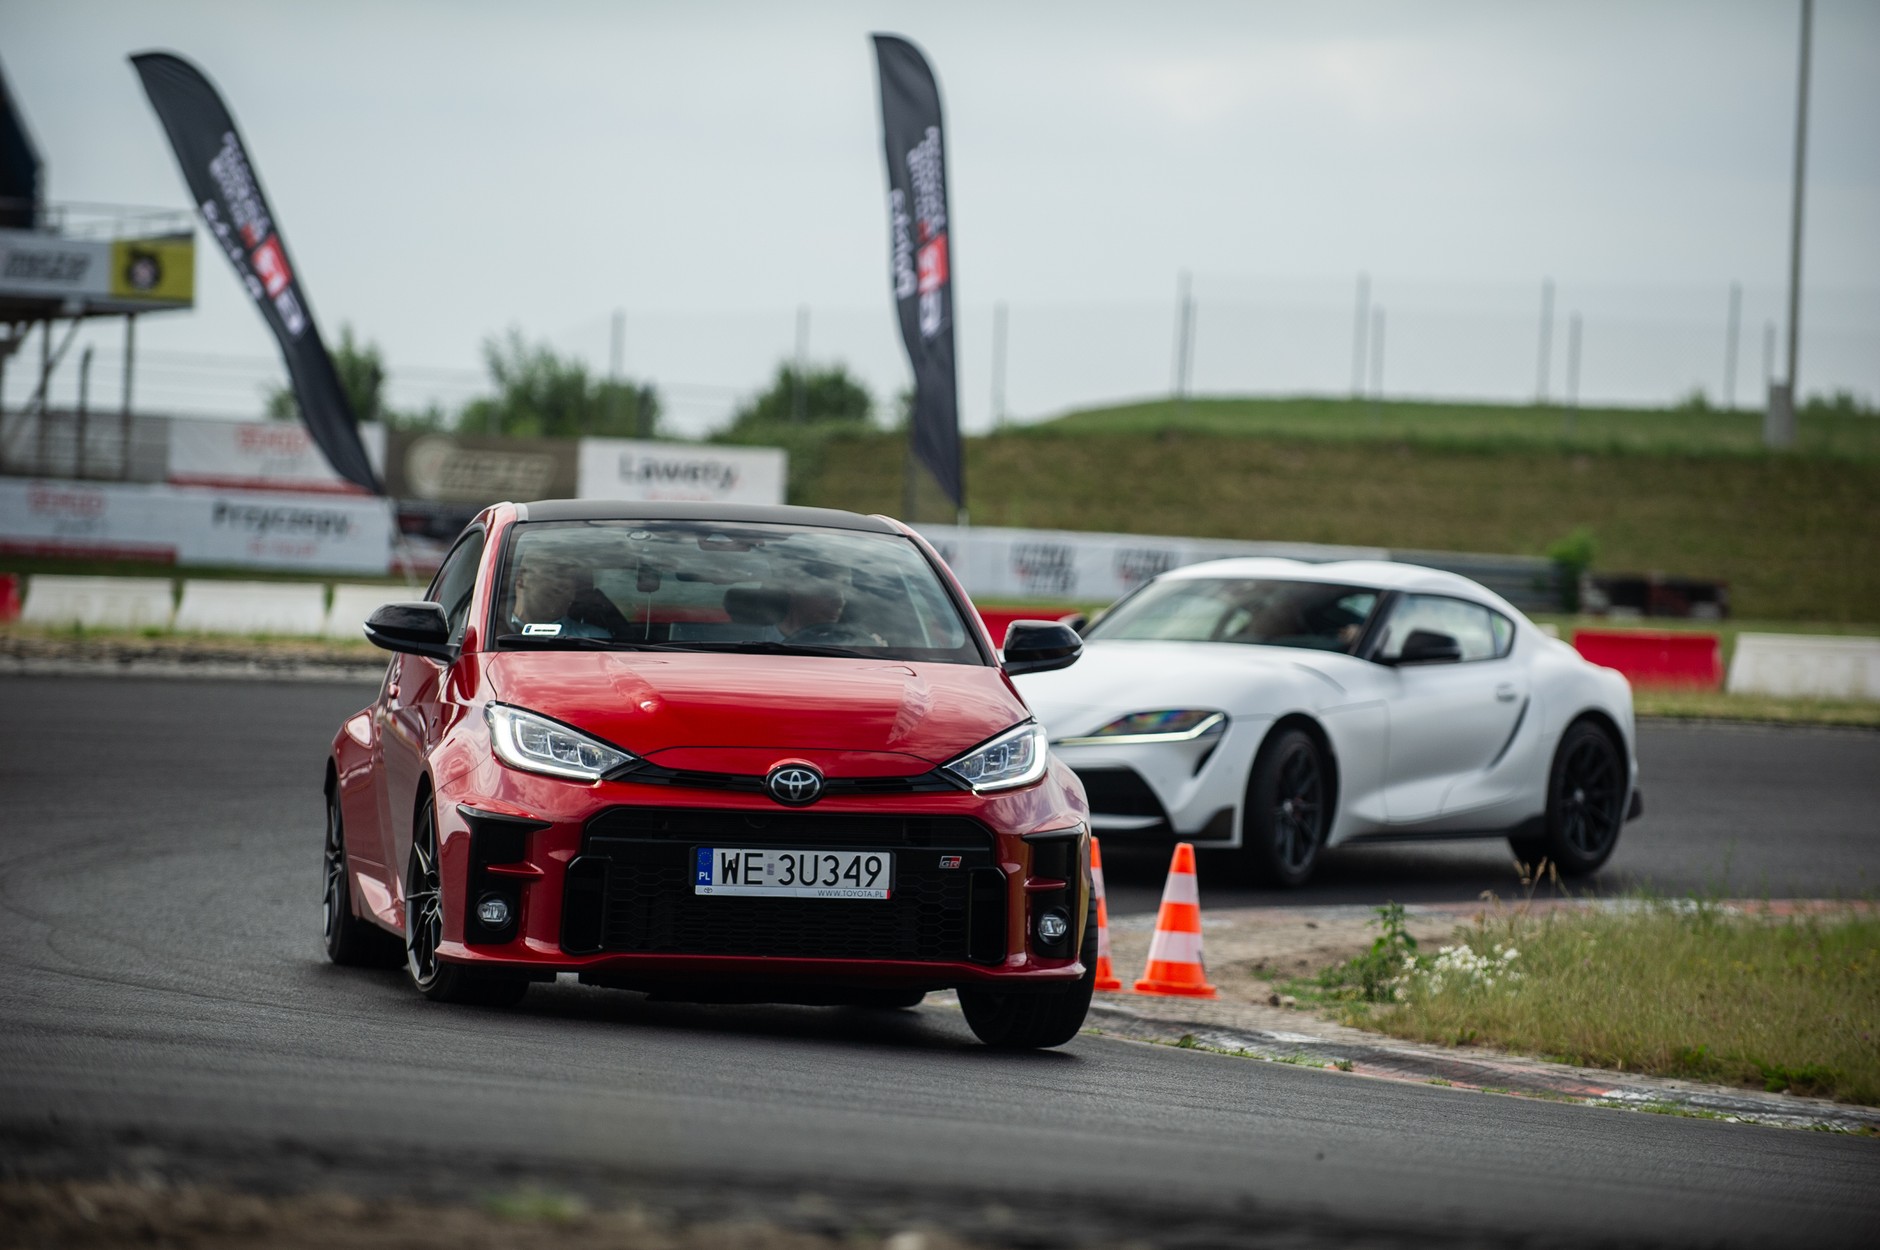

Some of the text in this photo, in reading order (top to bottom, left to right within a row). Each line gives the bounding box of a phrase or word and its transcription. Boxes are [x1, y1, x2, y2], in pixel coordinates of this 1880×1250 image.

[940, 858, 960, 868] GR
[721, 852, 882, 887] WE 3U349
[699, 871, 711, 880] PL
[817, 889, 884, 898] WWW.TOYOTA.PL
